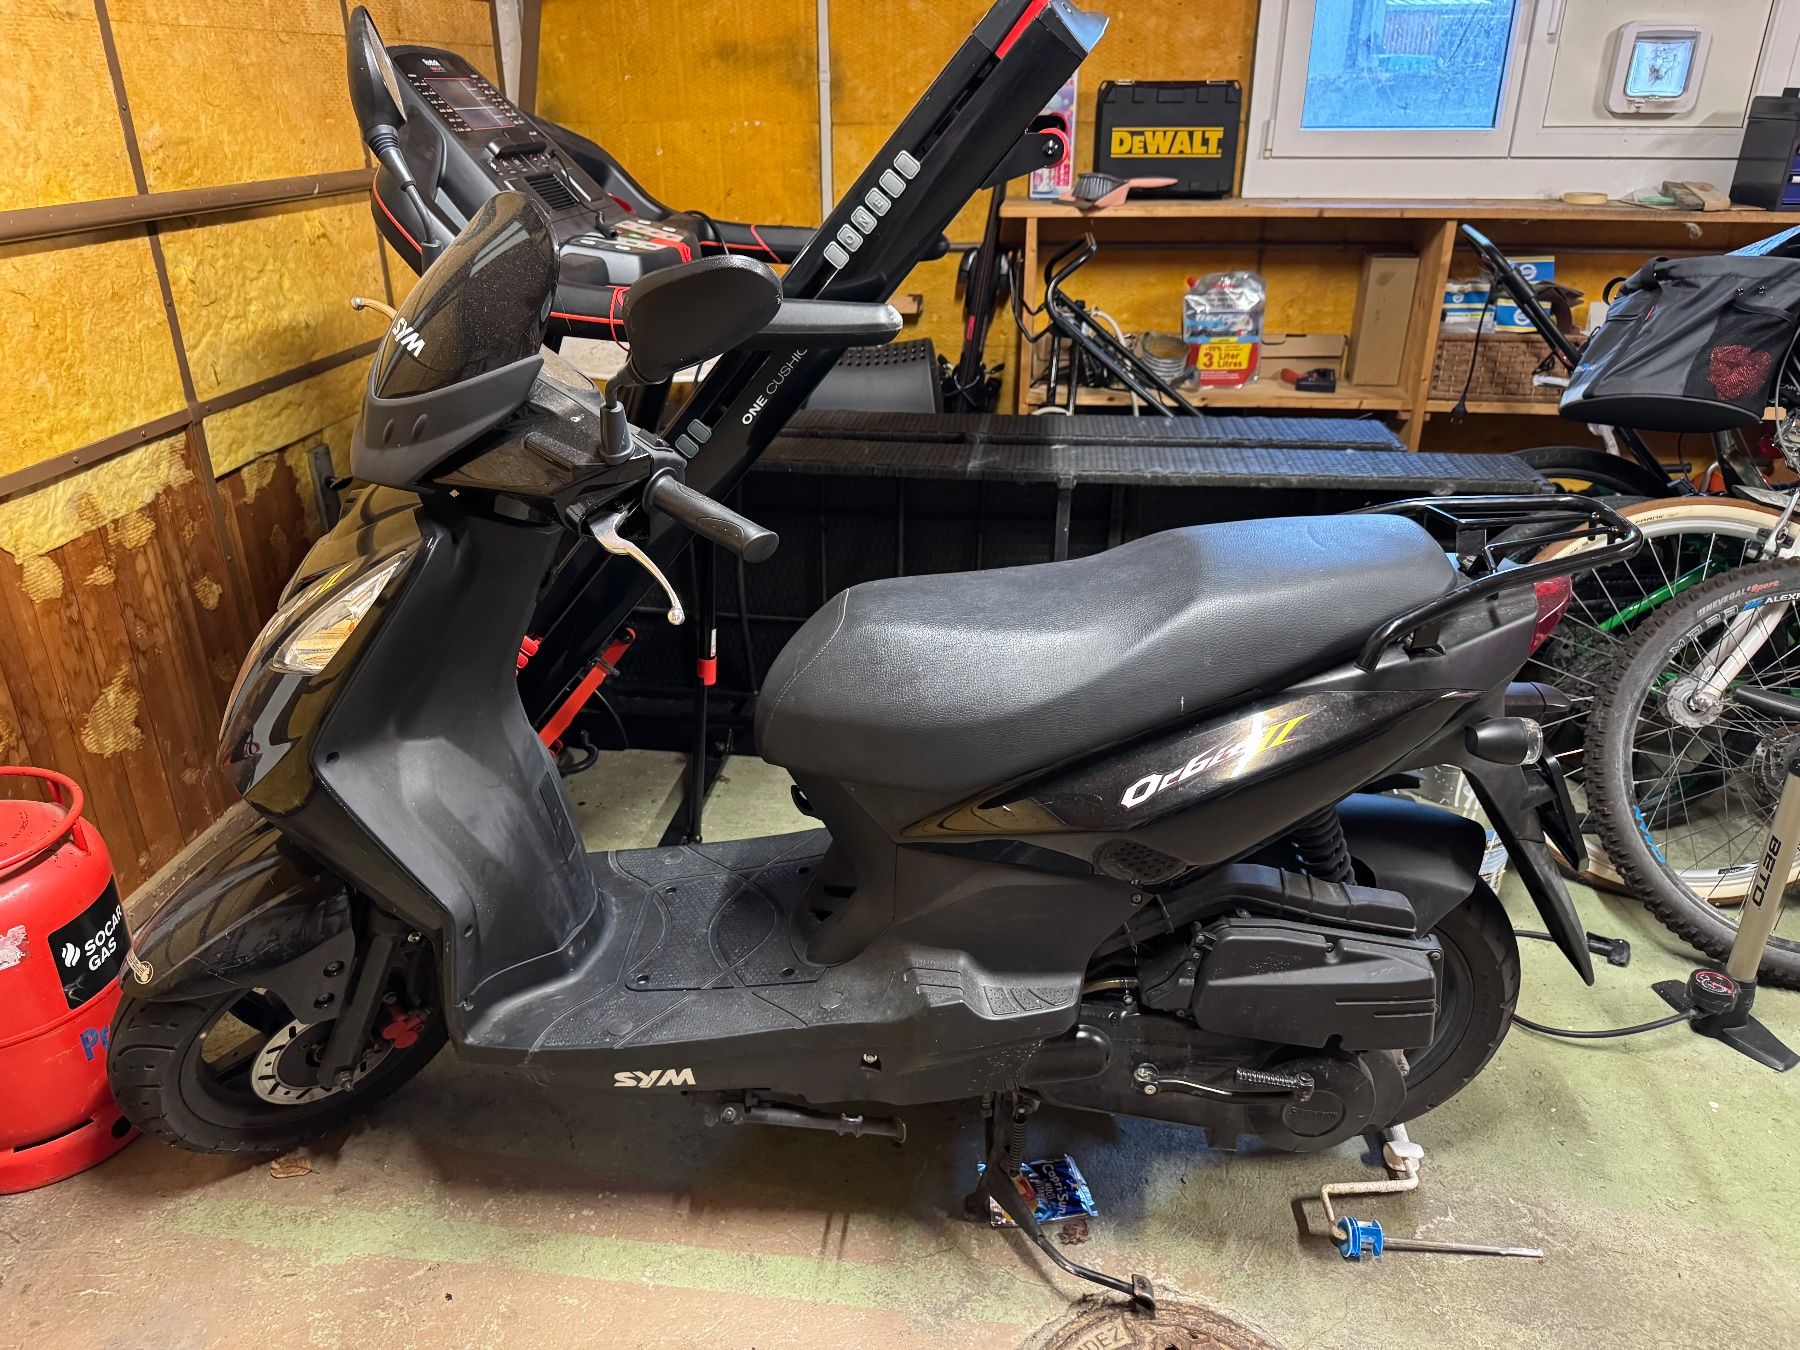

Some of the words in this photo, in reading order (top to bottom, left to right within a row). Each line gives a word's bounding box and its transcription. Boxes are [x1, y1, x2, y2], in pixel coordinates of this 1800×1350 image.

[392, 317, 426, 358] SYM
[1202, 352, 1215, 368] 3
[741, 394, 768, 425] ONE
[1752, 835, 1782, 908] BETO
[84, 904, 123, 957] SOCAR
[88, 936, 117, 971] GAS
[613, 1067, 697, 1089] SYM
[1041, 1163, 1069, 1214] Capri-Sun
